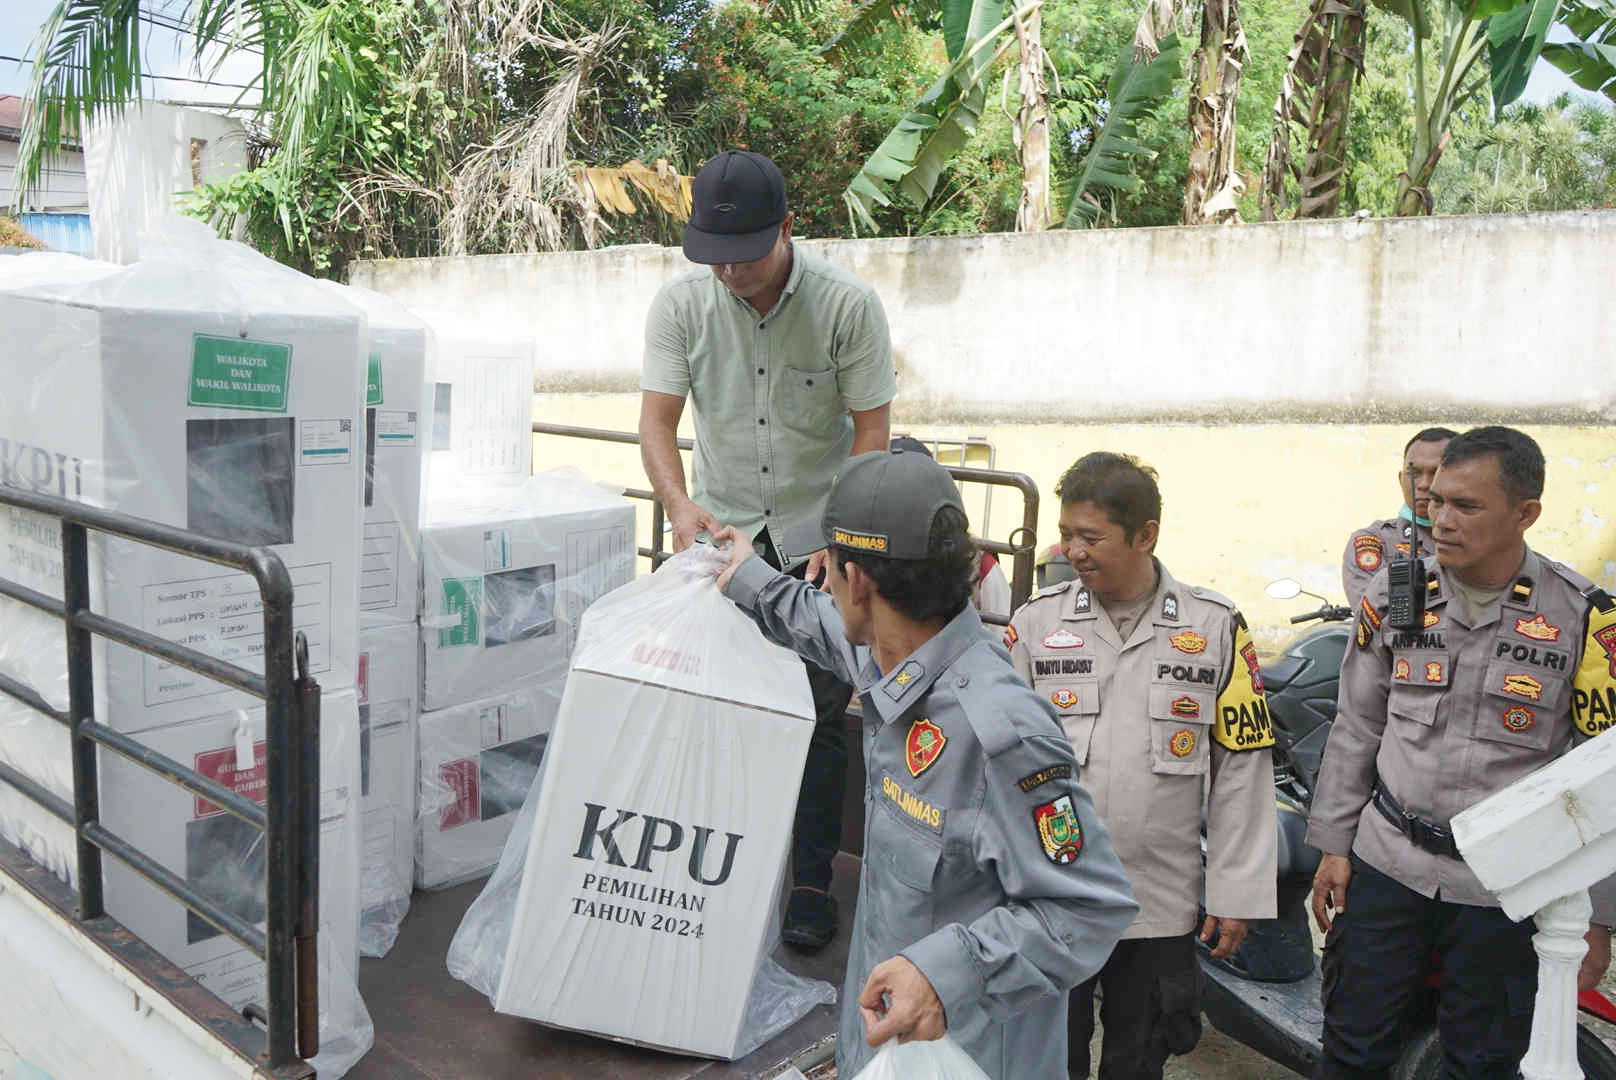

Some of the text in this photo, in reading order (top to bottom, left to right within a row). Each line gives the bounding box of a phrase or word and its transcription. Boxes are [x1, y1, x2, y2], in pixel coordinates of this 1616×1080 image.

[216, 353, 267, 368] WALIKOTA
[231, 367, 253, 378] DAN
[196, 378, 281, 393] WAKIL WALIKOTA
[1496, 642, 1568, 671] POLRI
[1157, 663, 1215, 684] POLRI
[1223, 699, 1271, 736] PAM
[1236, 732, 1264, 746] OMP
[883, 776, 940, 827] SATLINMAS
[572, 802, 744, 886] KPU
[582, 872, 706, 913] PEMILIHAN
[572, 897, 704, 939] TAHUN 2024
